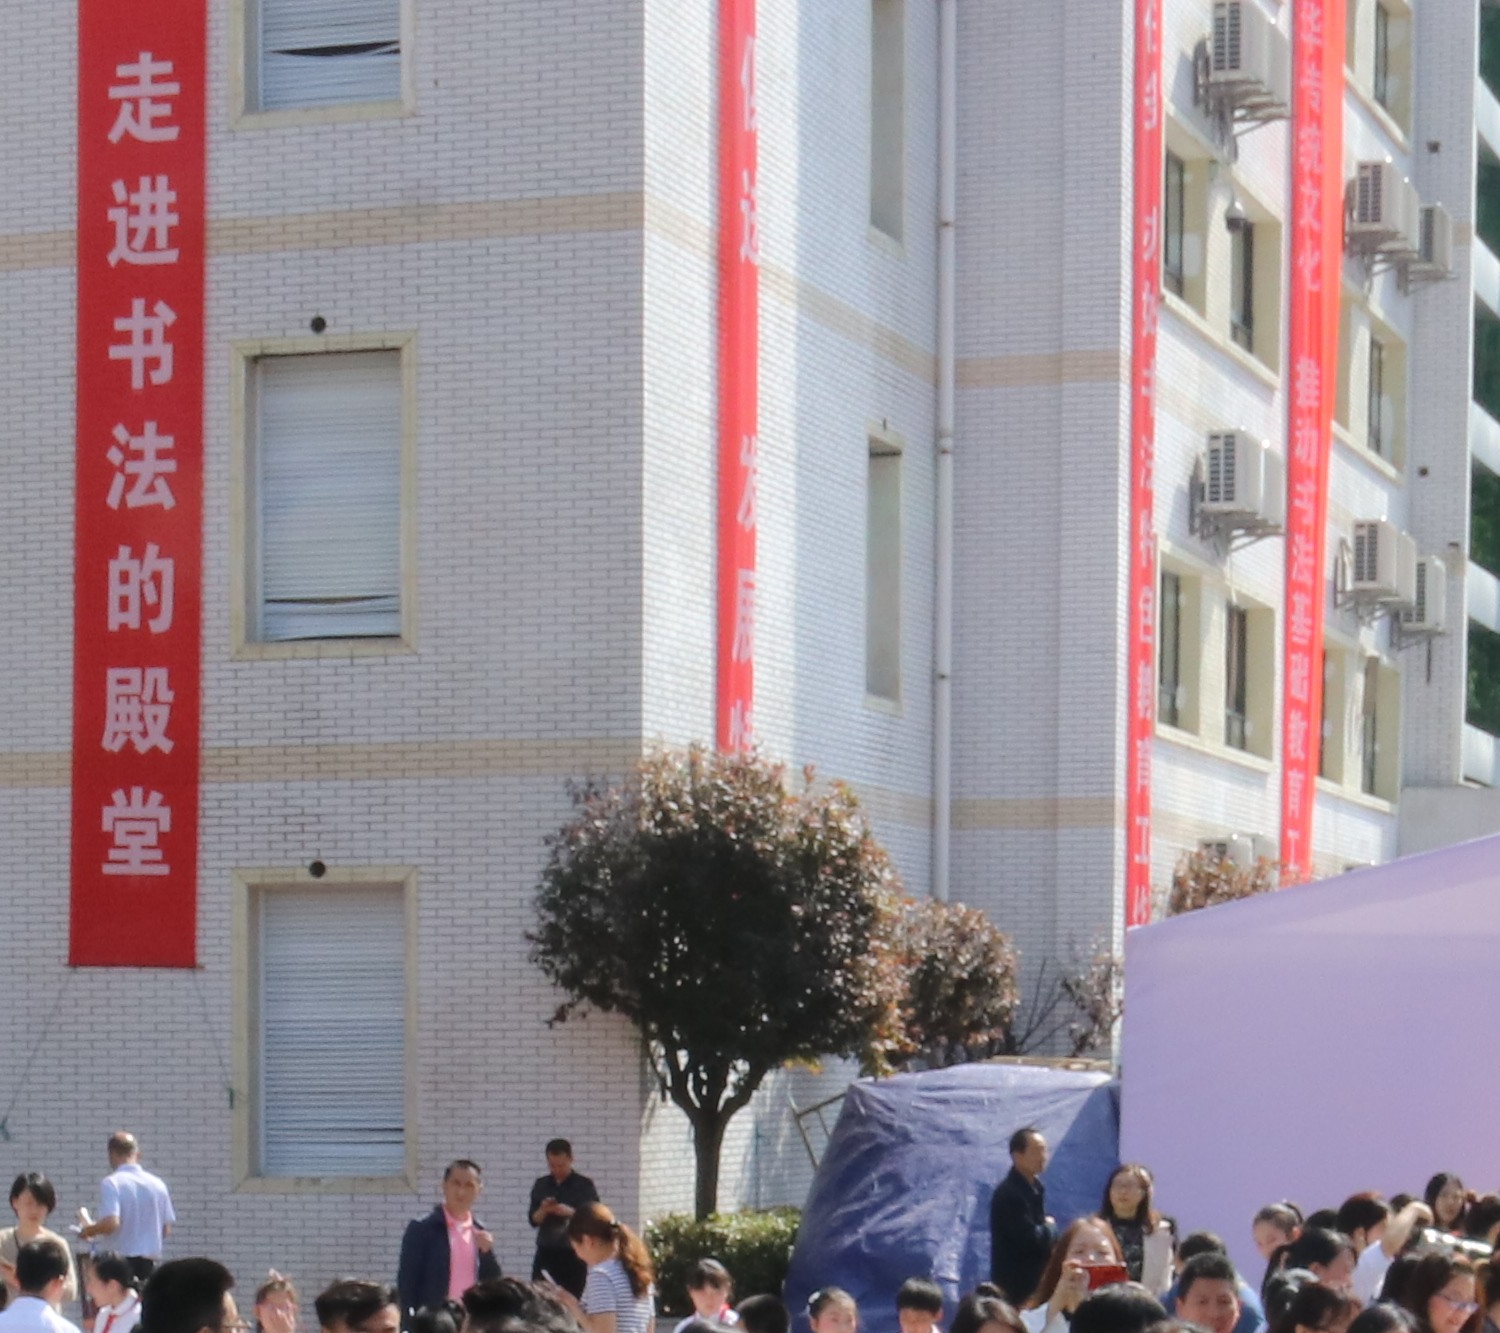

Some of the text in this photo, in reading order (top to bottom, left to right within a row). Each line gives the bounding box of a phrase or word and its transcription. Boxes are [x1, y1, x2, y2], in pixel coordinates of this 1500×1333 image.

[101, 52, 181, 877] 走进书法的殿堂
